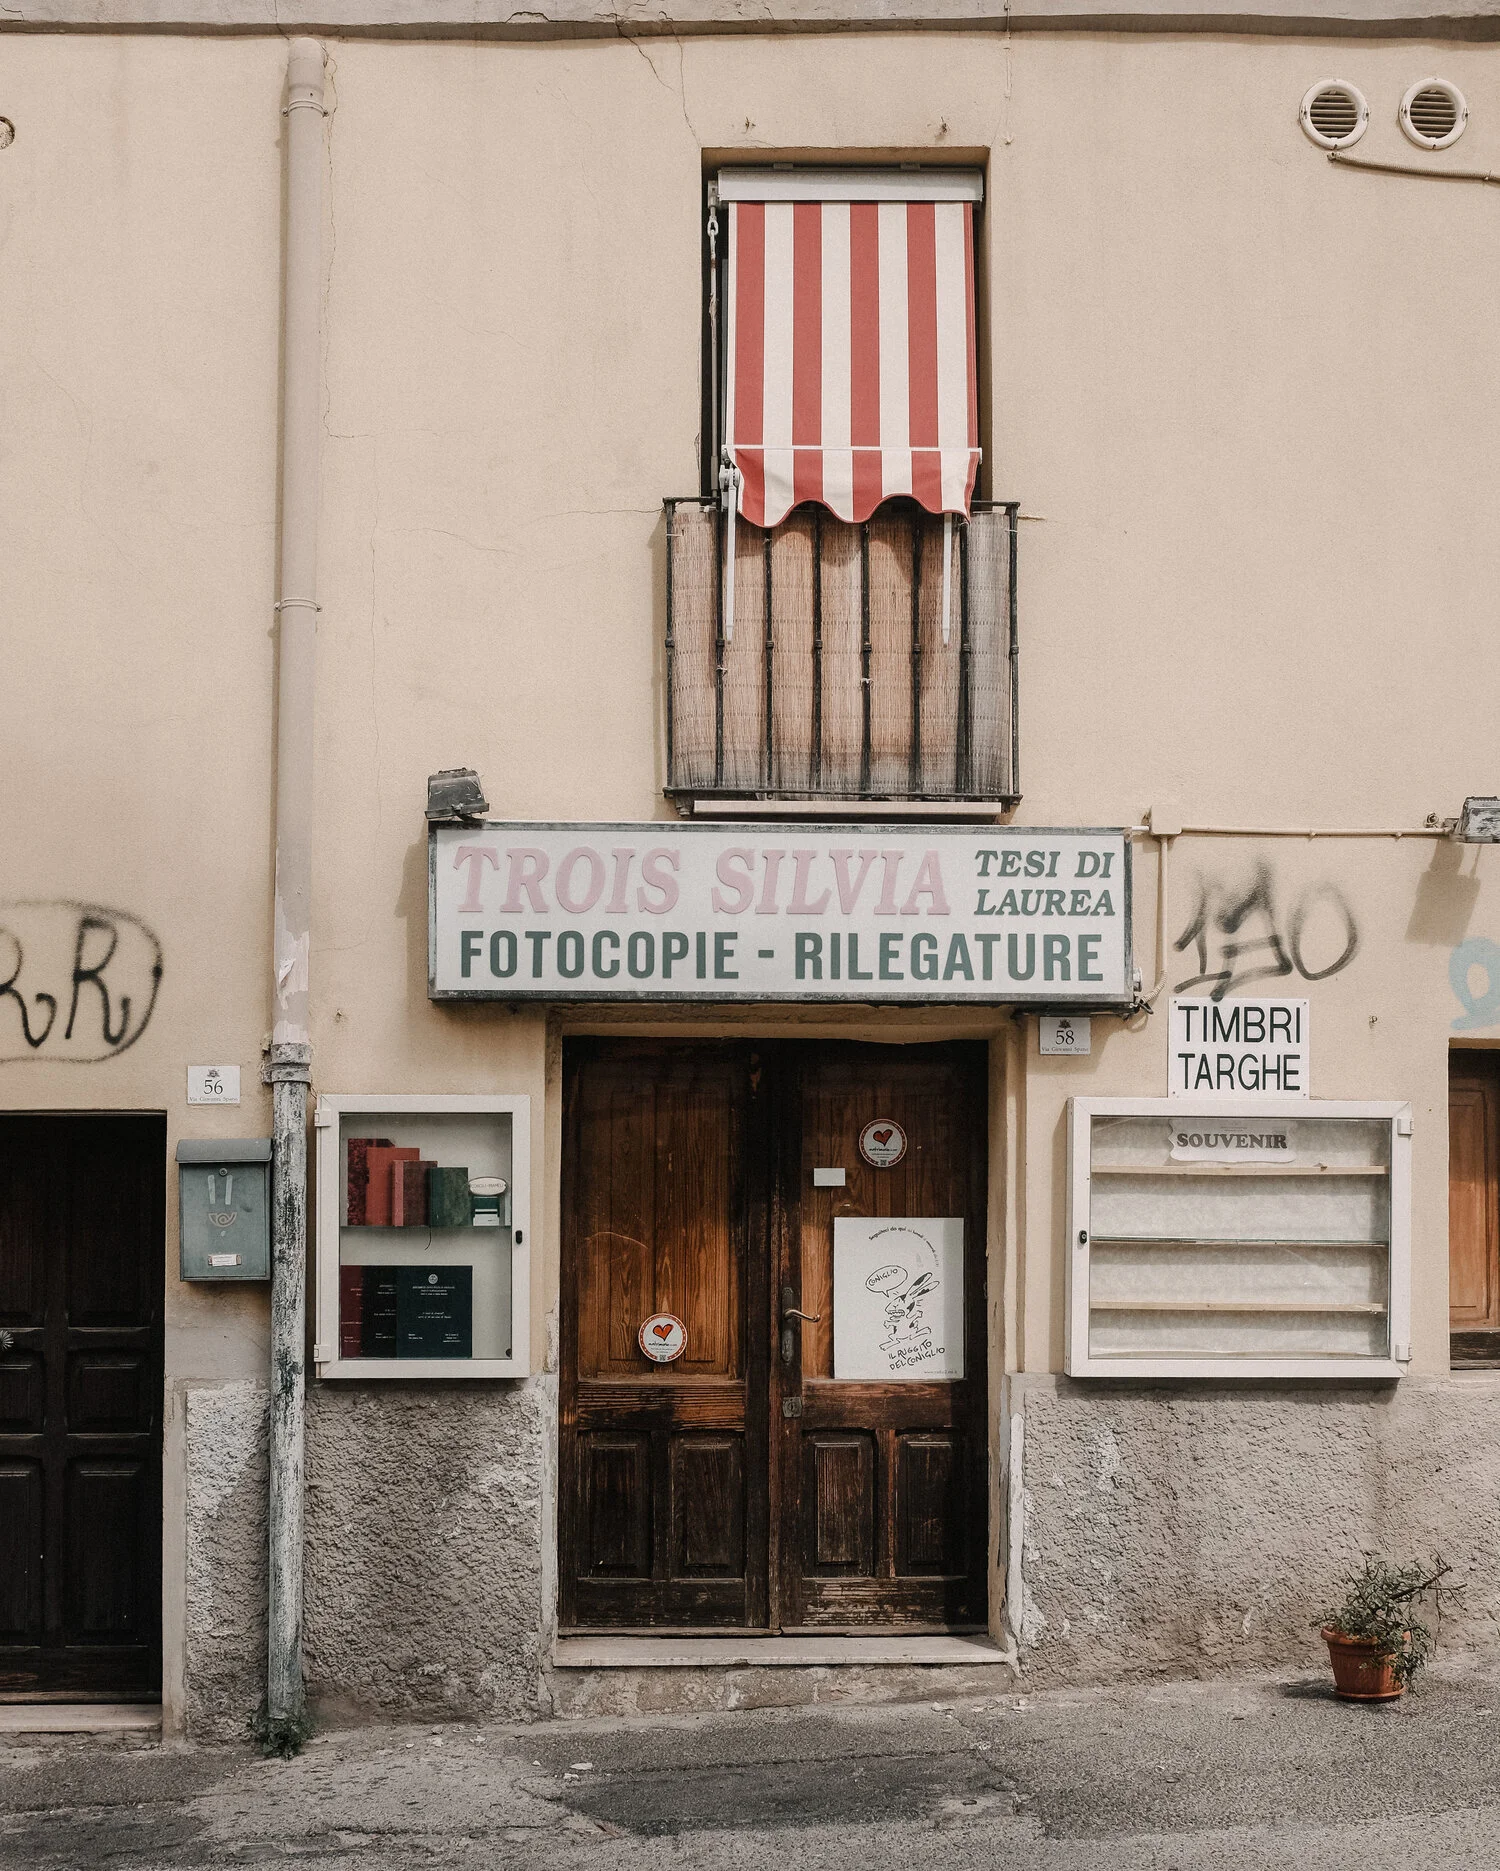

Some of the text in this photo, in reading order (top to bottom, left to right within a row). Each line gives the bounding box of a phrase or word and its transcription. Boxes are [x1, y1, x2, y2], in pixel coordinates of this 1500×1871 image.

[974, 850, 1115, 879] TESI DI
[454, 846, 951, 915] TROIS SILVIA
[973, 889, 1116, 917] LAUREA
[460, 930, 739, 980] FOTOCOPIE
[794, 932, 1104, 982] RILEGATURE
[1055, 1030, 1074, 1045] 58
[1177, 1005, 1301, 1044] TIMBRI
[1177, 1053, 1301, 1091] TARGHE
[203, 1079, 224, 1095] 56
[1176, 1132, 1288, 1150] SOUVENIR
[869, 1269, 898, 1286] CONIGLIO
[889, 1346, 946, 1371] DEL CONIGLIO
[897, 1338, 933, 1360] RUGGITO
